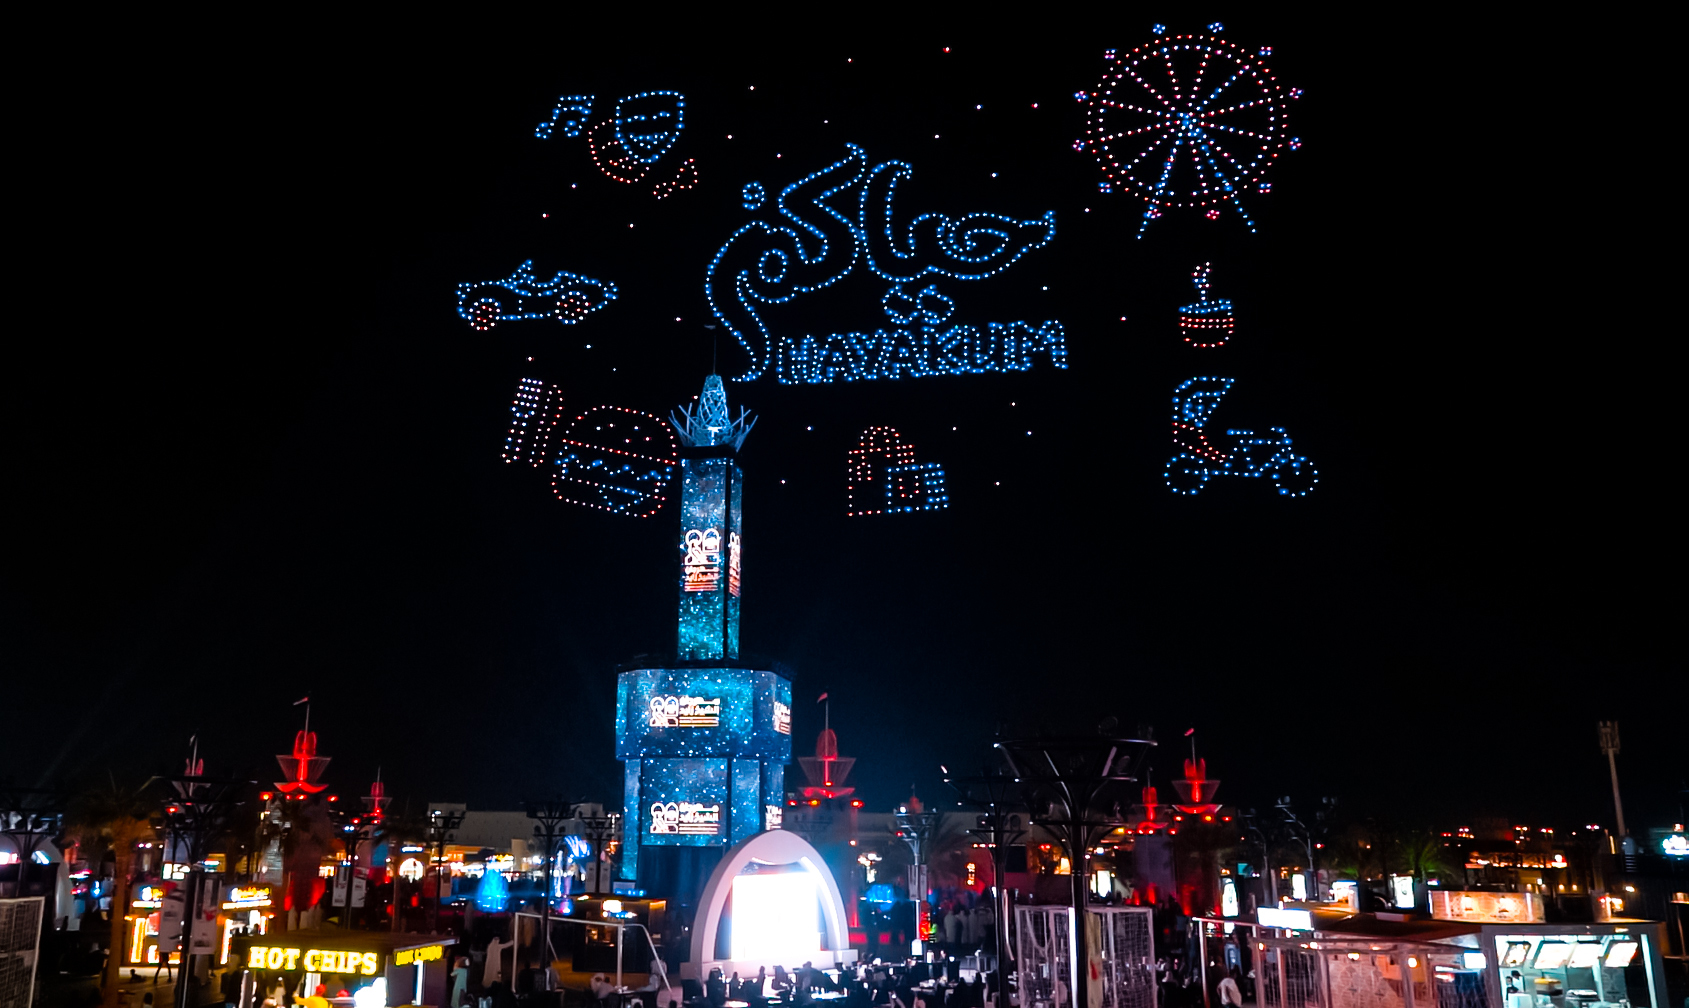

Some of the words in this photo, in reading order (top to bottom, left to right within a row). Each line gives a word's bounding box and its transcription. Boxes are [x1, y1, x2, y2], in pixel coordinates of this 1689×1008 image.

[775, 319, 1069, 384] HAYAKUM
[248, 946, 300, 970] HOT
[304, 949, 377, 975] CHIPS
